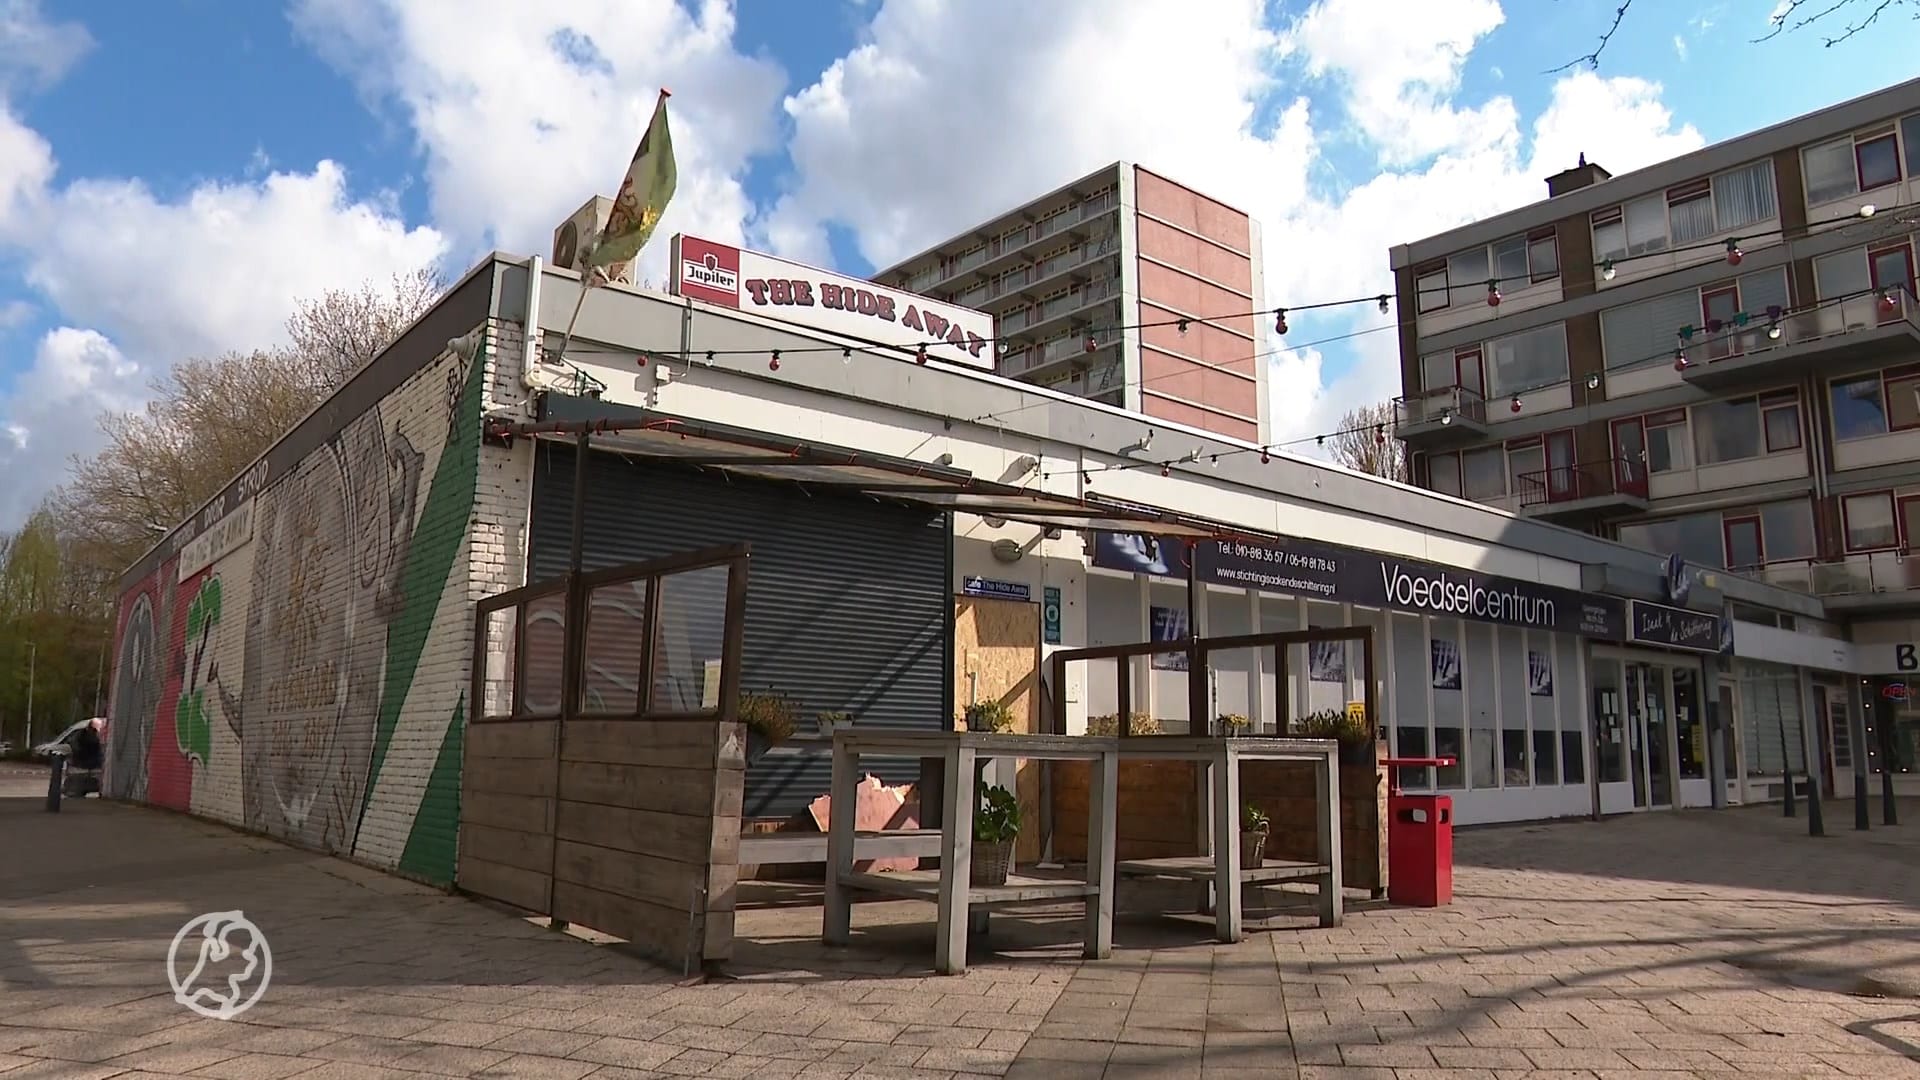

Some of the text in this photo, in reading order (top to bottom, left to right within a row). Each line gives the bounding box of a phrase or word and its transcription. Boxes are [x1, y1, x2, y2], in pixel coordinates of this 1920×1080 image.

[688, 265, 734, 287] Jupiler
[745, 279, 987, 359] THE HIDE AWAY
[1317, 558, 1326, 571] 78
[996, 583, 1010, 592] Hide
[1381, 561, 1555, 626] Voedselcentrum
[1881, 687, 1918, 698] OPEN
